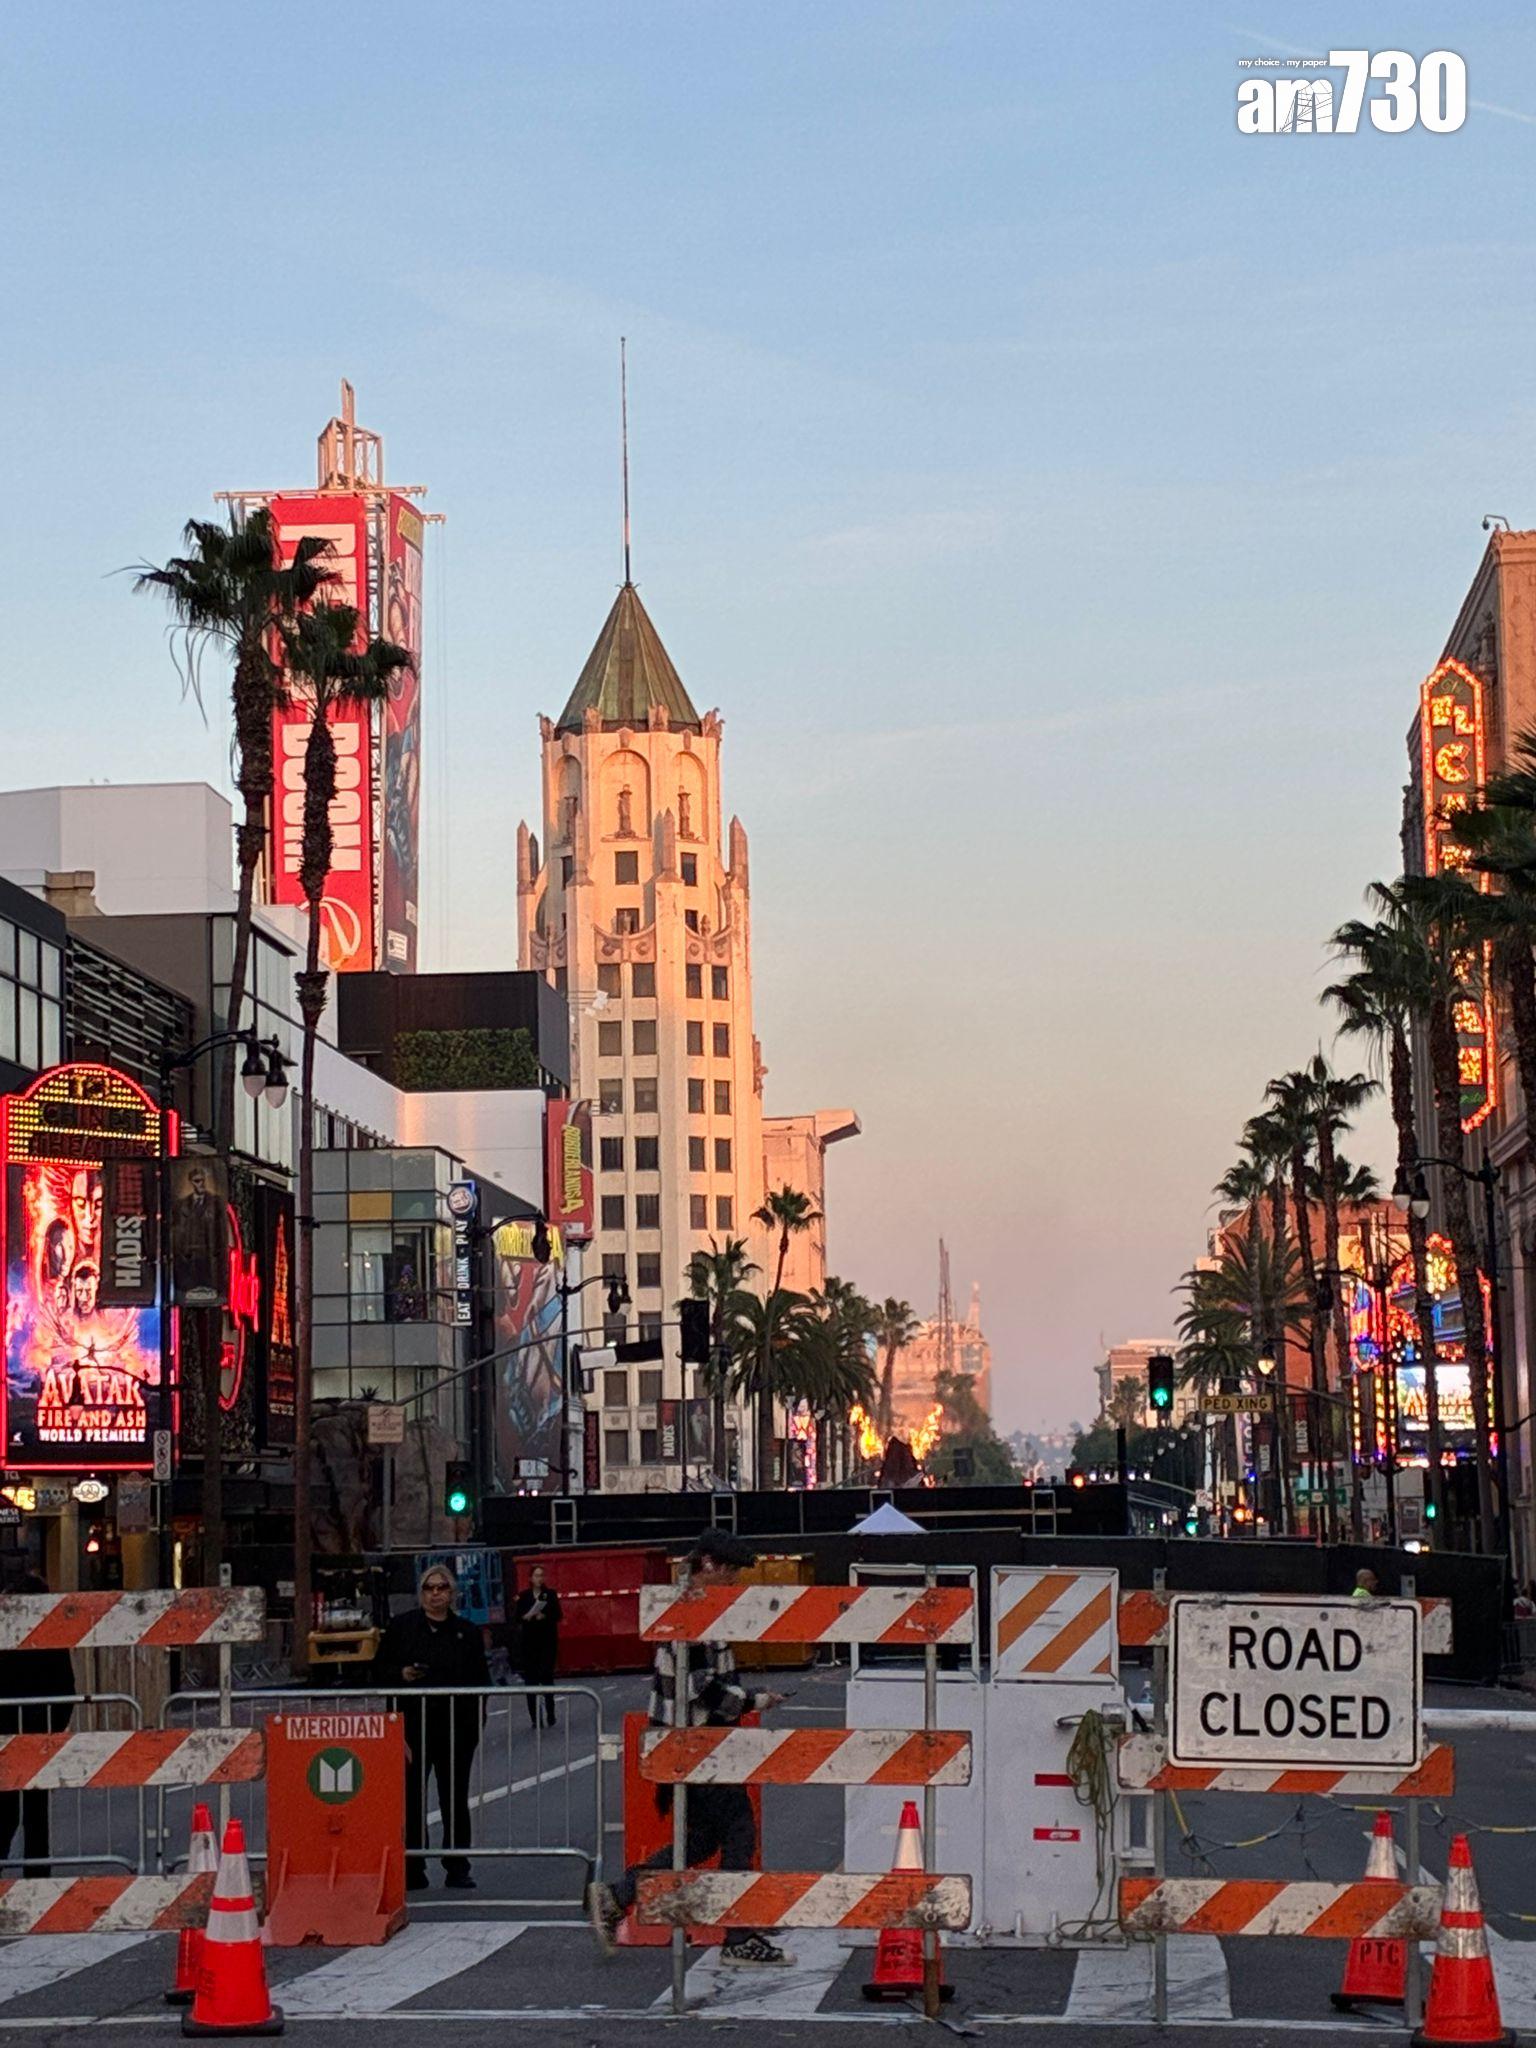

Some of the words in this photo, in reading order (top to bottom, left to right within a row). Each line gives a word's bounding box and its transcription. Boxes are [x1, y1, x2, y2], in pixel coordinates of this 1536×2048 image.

[455, 1256, 471, 1290] DRINK
[456, 1301, 471, 1320] EAT
[1204, 1398, 1232, 1410] PED
[1236, 1397, 1269, 1410] XING
[37, 1409, 73, 1427] FIRE
[77, 1410, 112, 1428] AND
[113, 1410, 146, 1428] ASH
[38, 1429, 83, 1442] WORLD
[85, 1428, 146, 1442] PREMIERE
[1228, 1626, 1363, 1672] ROAD
[290, 1715, 382, 1738] MERIDIAN
[1199, 1691, 1391, 1740] CLOSED
[1359, 1941, 1399, 1966] PTC
